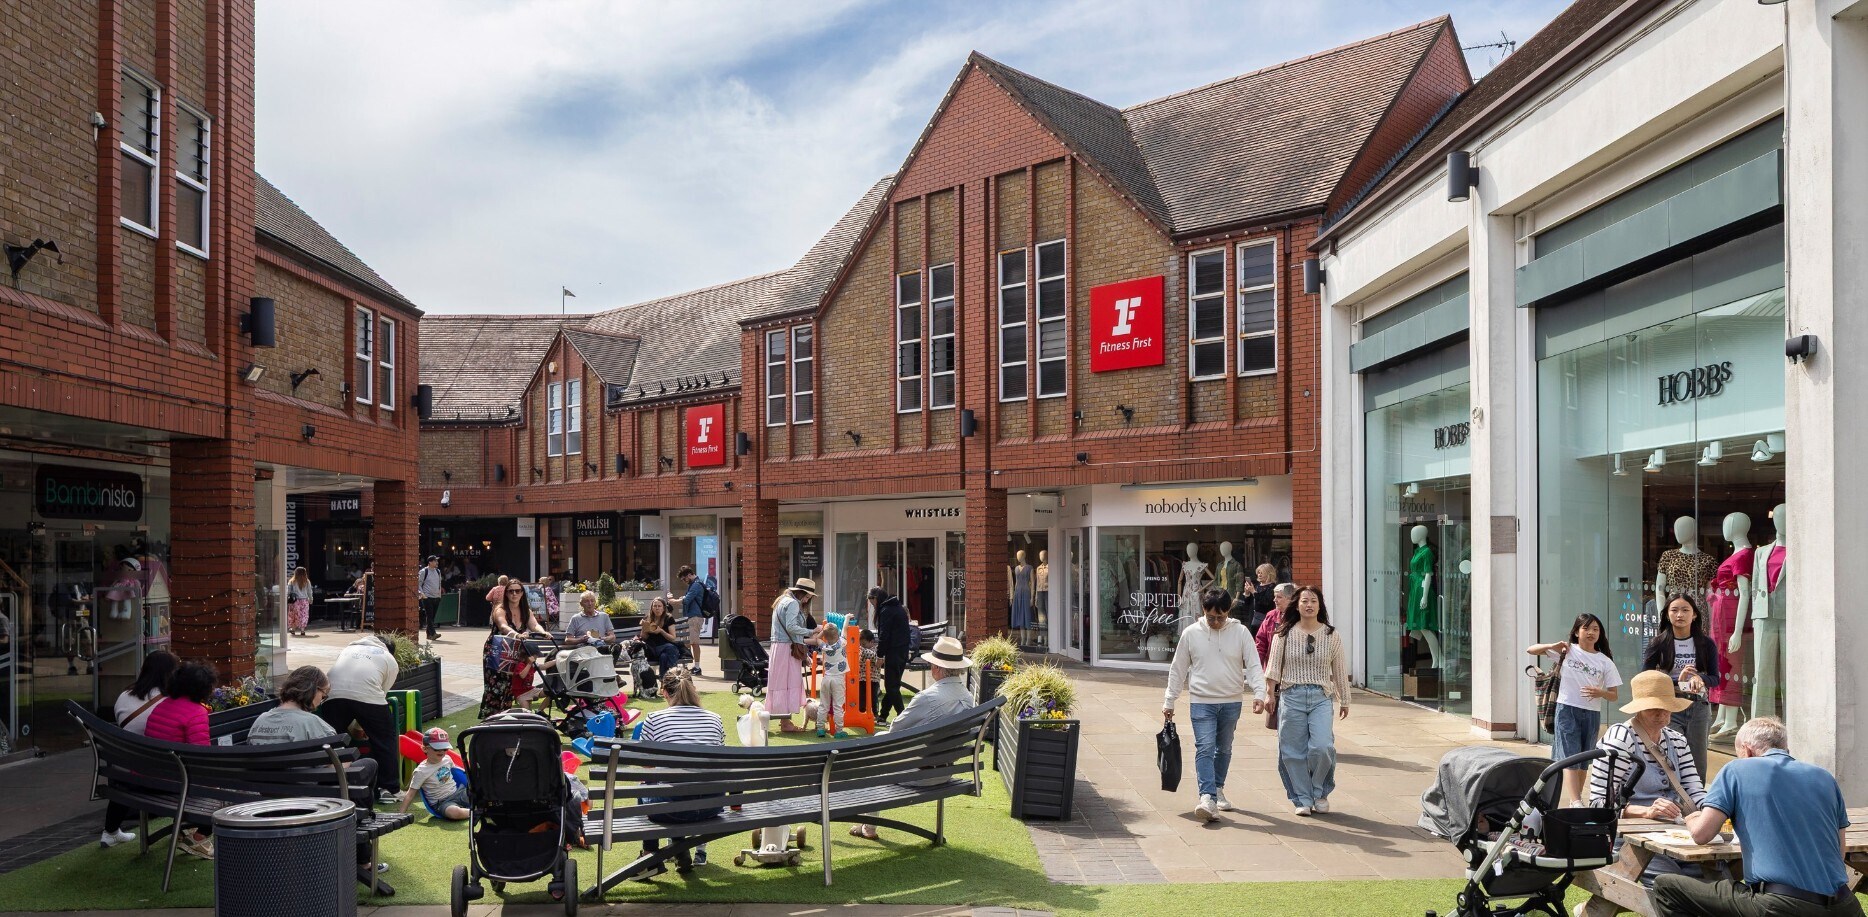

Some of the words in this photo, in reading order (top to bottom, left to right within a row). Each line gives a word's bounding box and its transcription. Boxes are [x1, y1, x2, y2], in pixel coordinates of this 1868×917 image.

[46, 479, 136, 508] Bambinista
[331, 500, 358, 511] HATCH
[1145, 498, 1206, 517] nobody’s
[1210, 496, 1246, 512] child
[905, 508, 960, 518] WHISTLES
[1130, 592, 1182, 608] SPIRITED
[1625, 613, 1648, 622] COME
[1628, 626, 1640, 635] OR
[1643, 627, 1658, 637] SHI
